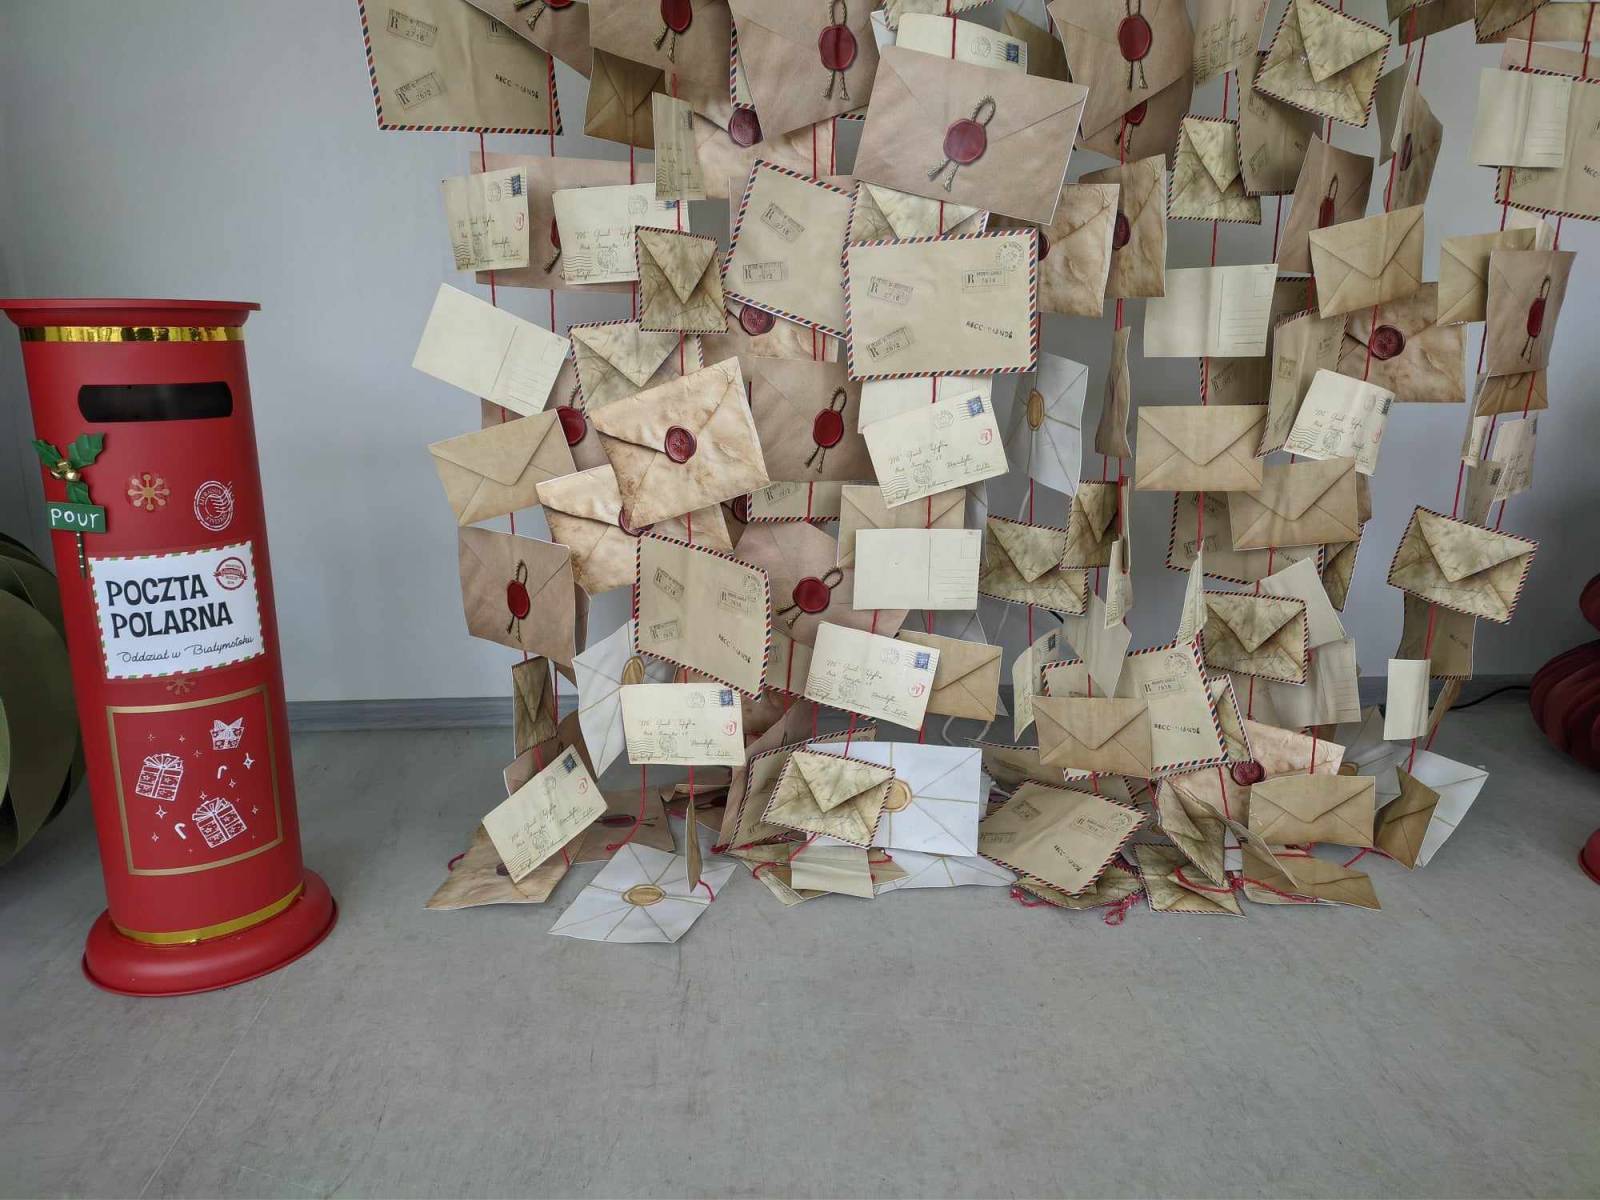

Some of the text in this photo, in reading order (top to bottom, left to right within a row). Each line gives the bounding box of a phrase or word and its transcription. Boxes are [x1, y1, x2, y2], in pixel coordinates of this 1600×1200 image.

[50, 507, 100, 528] pour
[105, 573, 209, 607] POCZTA
[110, 601, 234, 639] POLARNA
[171, 651, 182, 660] w
[183, 633, 255, 656] Białymstoku
